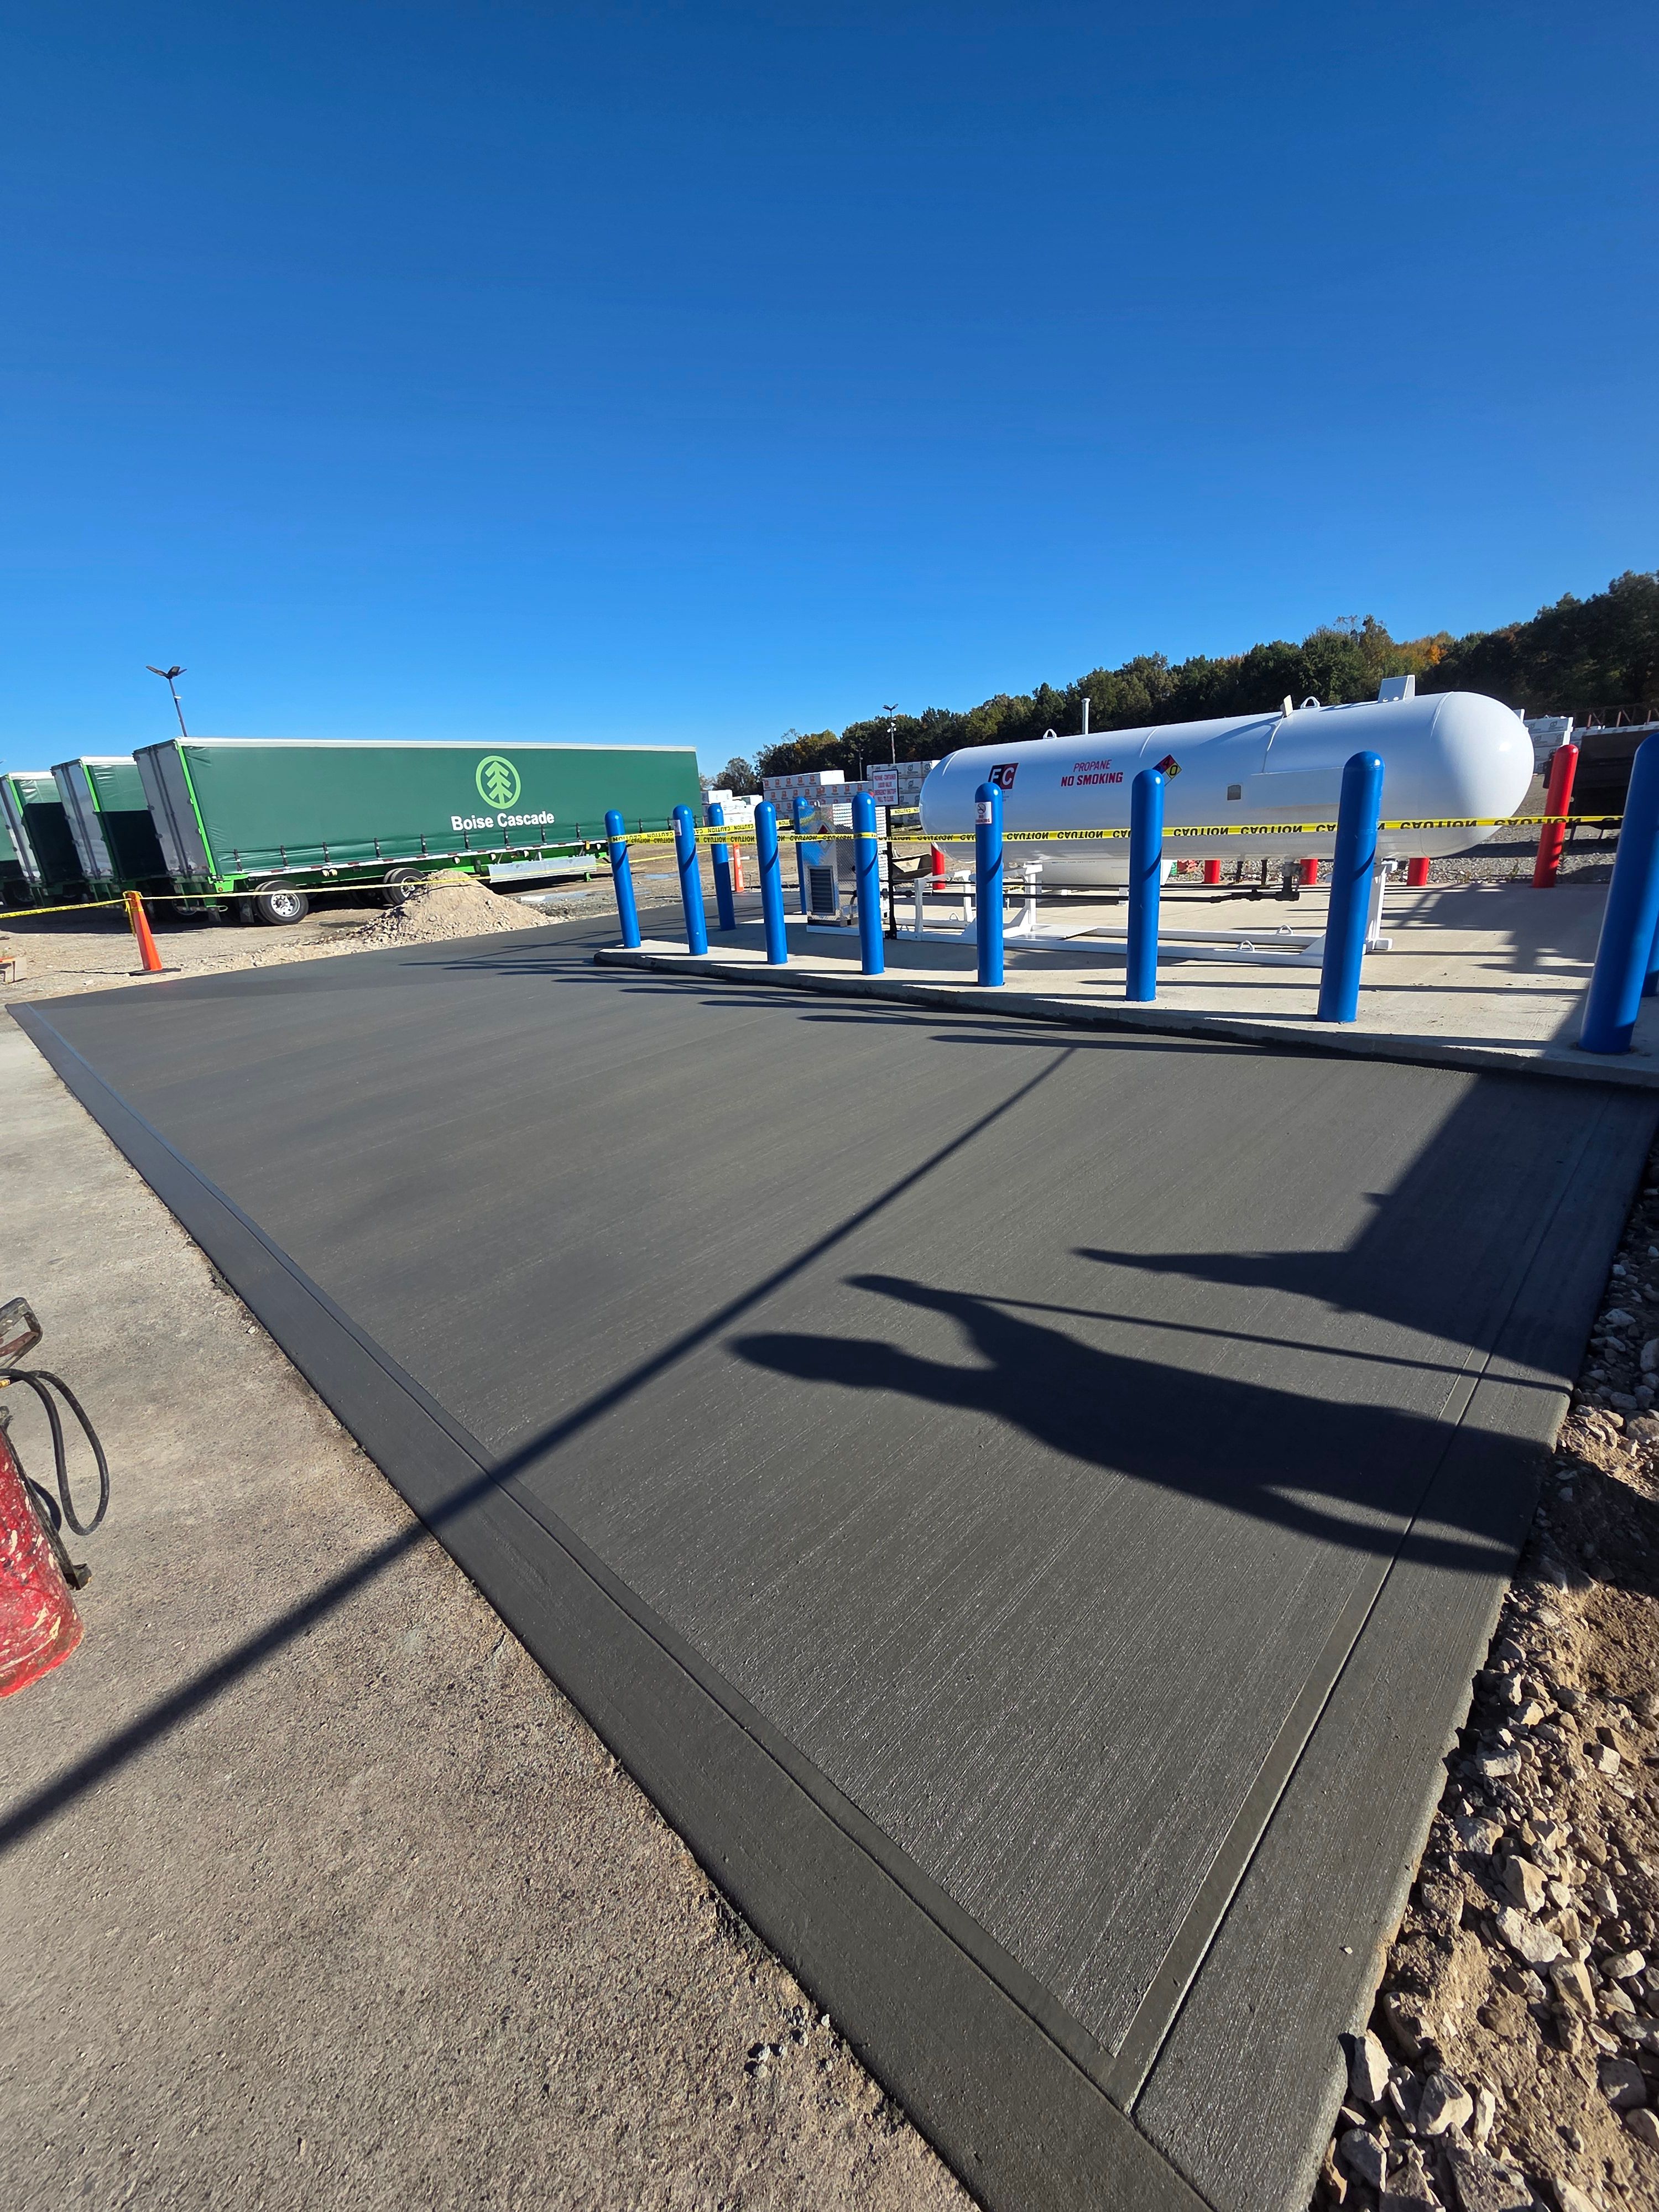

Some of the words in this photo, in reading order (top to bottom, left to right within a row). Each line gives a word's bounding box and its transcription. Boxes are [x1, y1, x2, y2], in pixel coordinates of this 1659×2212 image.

[1073, 759, 1112, 772] PROPANE
[1162, 757, 1171, 768] 4
[1061, 776, 1074, 786] NO
[1077, 772, 1123, 785] SMOKING
[451, 815, 494, 831] Boise
[497, 811, 555, 827] Cascade
